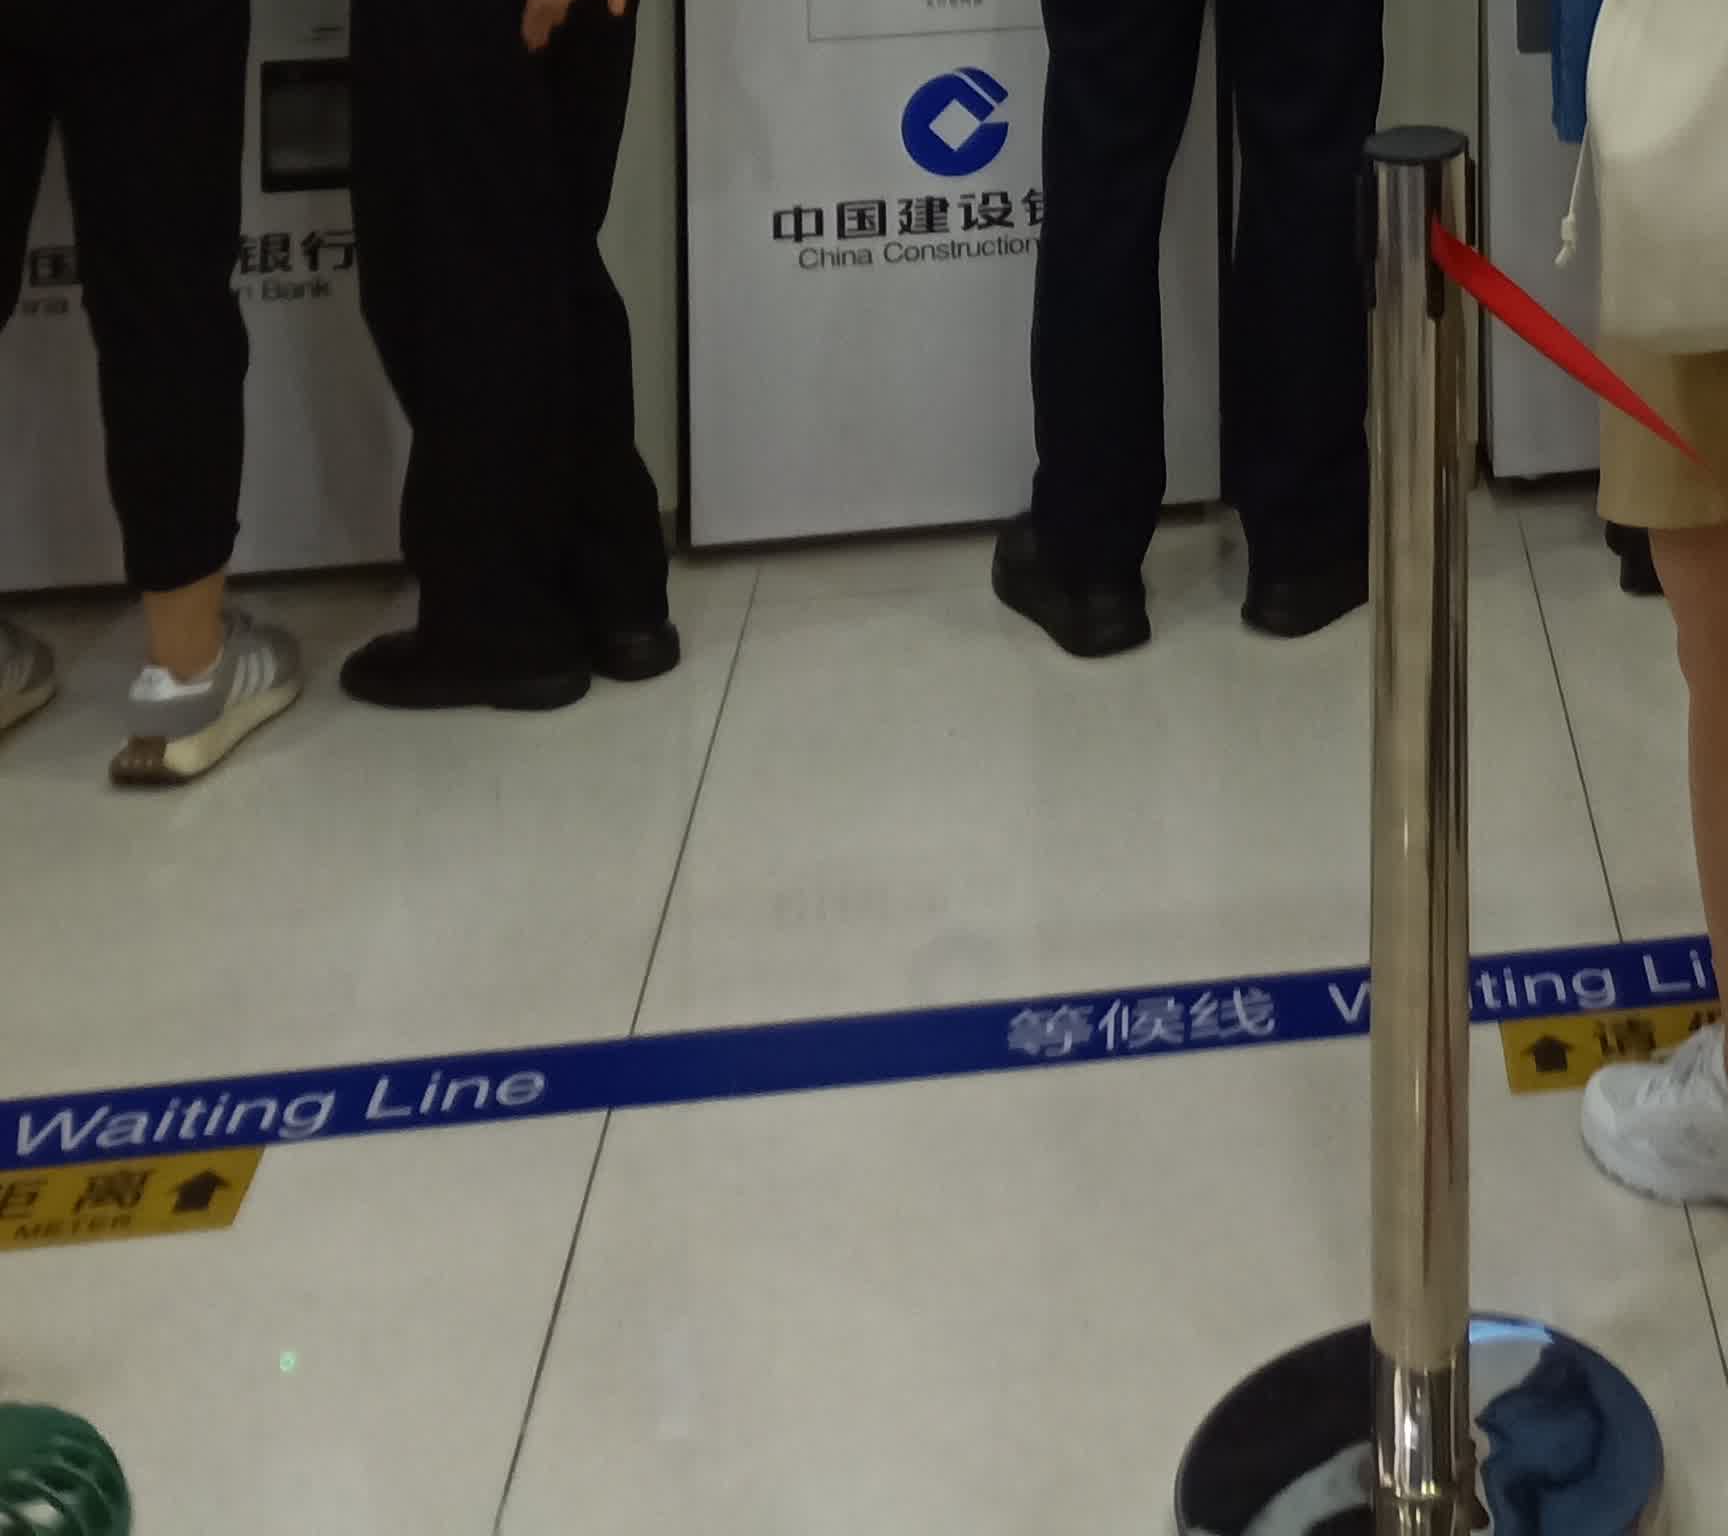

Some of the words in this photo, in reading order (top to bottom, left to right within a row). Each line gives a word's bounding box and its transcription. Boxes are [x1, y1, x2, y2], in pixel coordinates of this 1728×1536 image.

[798, 245, 873, 271] China
[883, 231, 1041, 264] Construction
[1006, 986, 1275, 1058] 等候线
[15, 1088, 336, 1157] Waiting
[365, 1069, 546, 1121] Line
